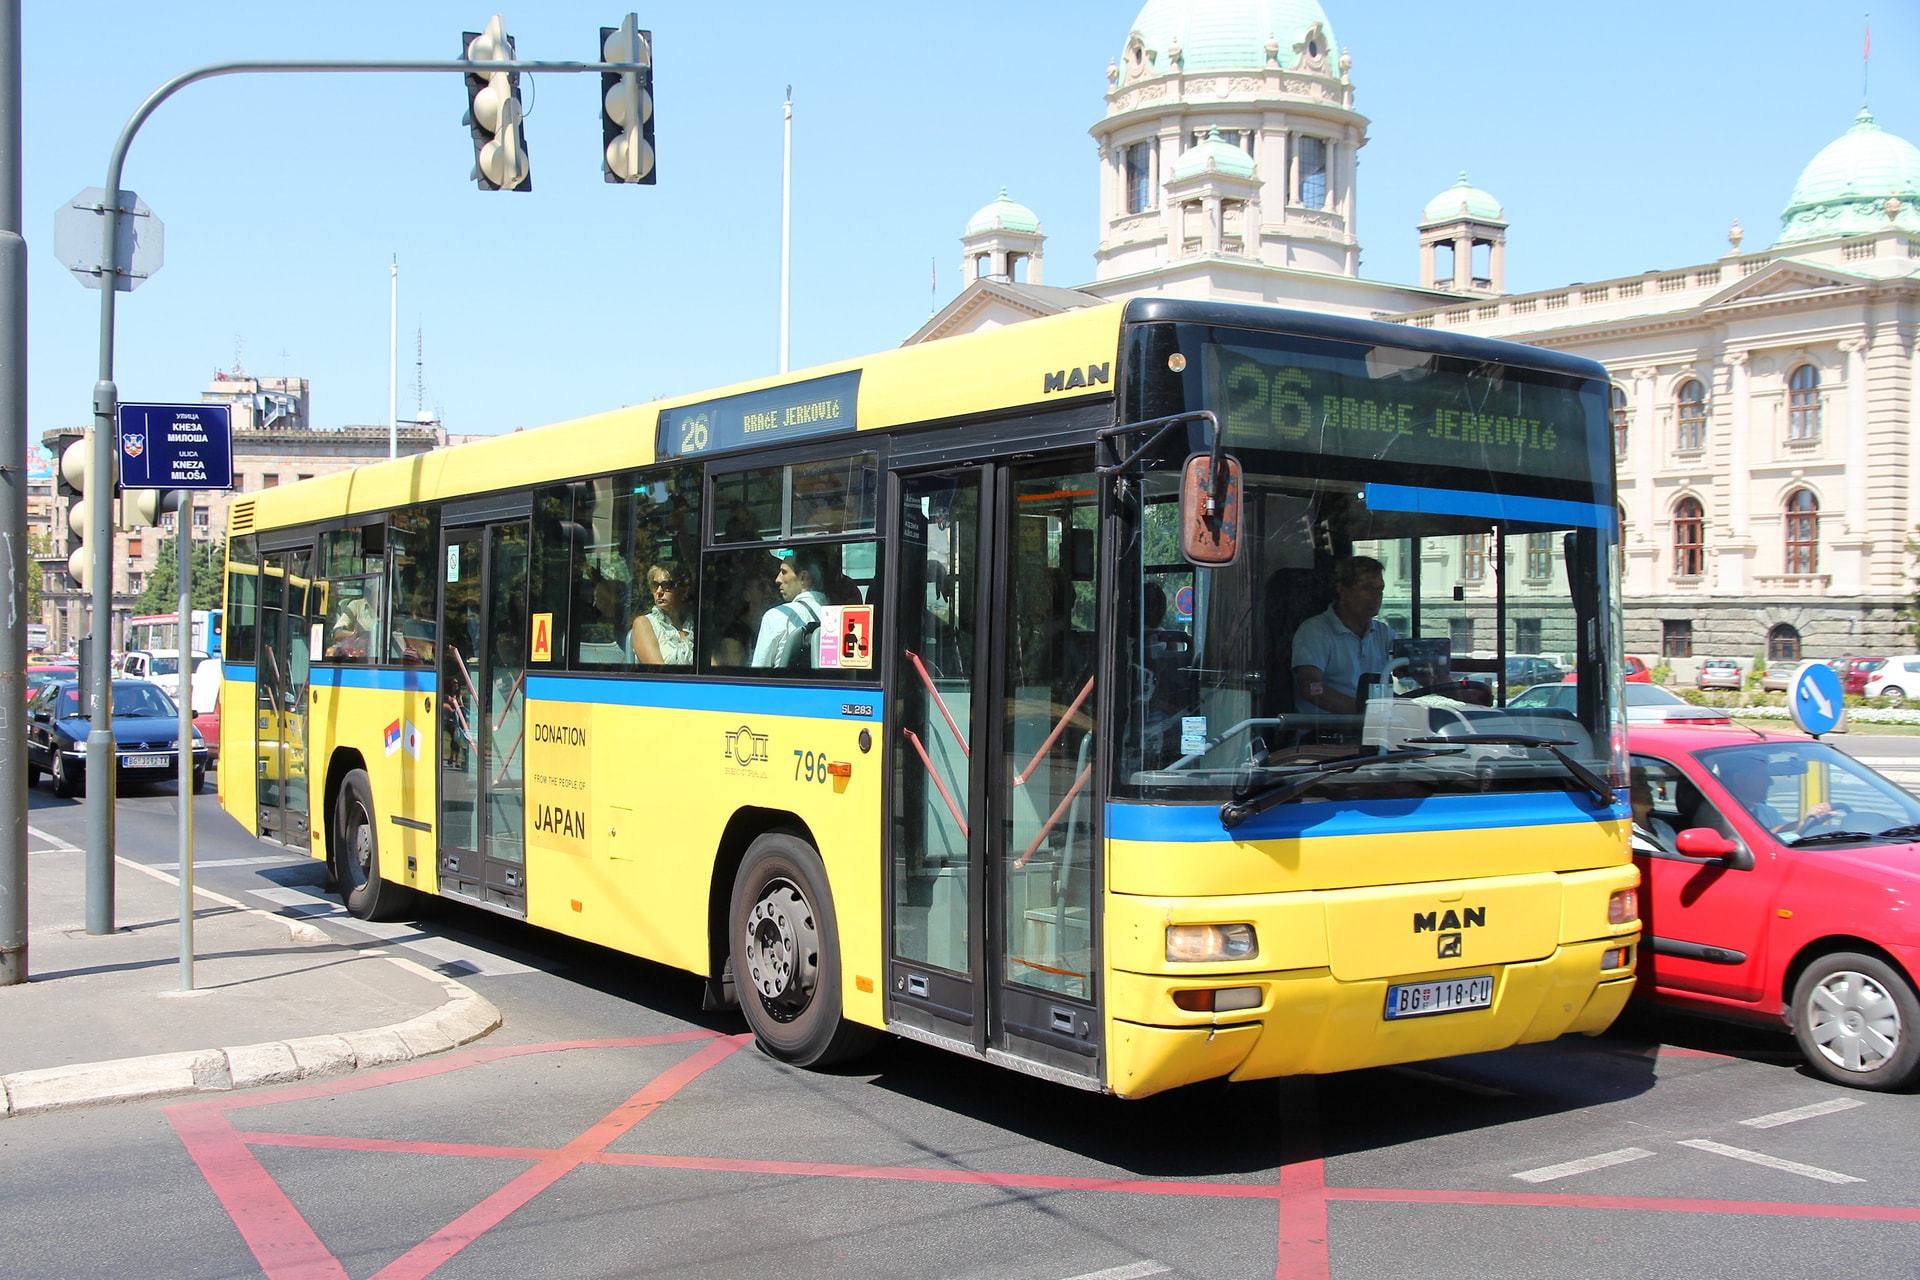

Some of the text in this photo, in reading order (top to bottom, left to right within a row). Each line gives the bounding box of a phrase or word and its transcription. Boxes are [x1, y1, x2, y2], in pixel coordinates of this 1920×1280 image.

[1043, 362, 1110, 394] MAN
[1227, 362, 1312, 440] 26
[167, 434, 208, 442] МИЛОША
[172, 423, 203, 431] КНЕЗА
[681, 413, 709, 453] 26
[171, 470, 207, 480] MILOŠA
[172, 461, 205, 469] KNEZA
[535, 620, 549, 652] A
[841, 704, 872, 715] SL 283
[534, 723, 586, 747] DONATION
[793, 750, 827, 784] 796
[534, 774, 586, 790] FROM THE PEOPLE OF
[534, 803, 585, 840] JAPAN
[1413, 906, 1486, 933] MAN
[1400, 988, 1421, 1012] BG
